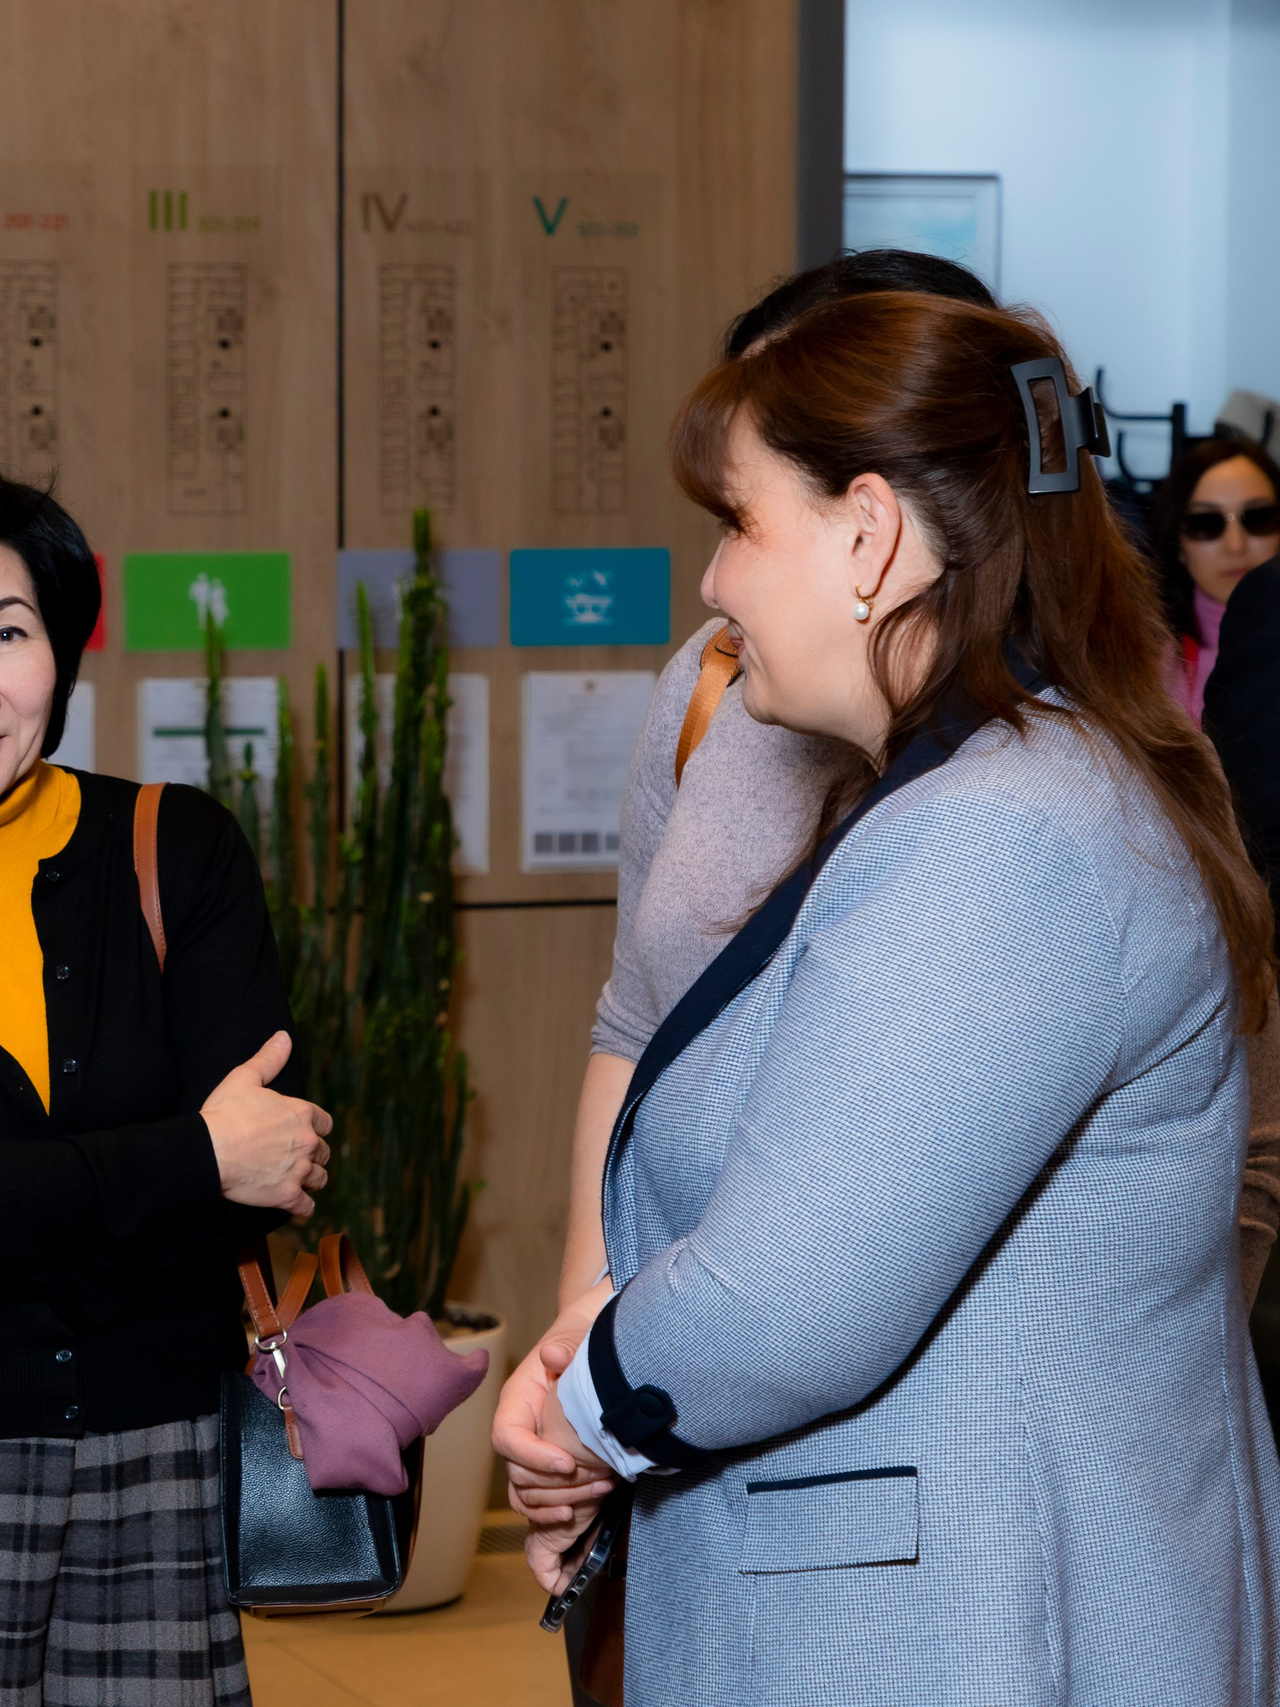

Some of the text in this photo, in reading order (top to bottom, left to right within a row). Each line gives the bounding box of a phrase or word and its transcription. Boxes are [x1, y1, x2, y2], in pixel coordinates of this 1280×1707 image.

[148, 190, 189, 231] III
[361, 192, 409, 233] IV
[533, 196, 569, 236] V
